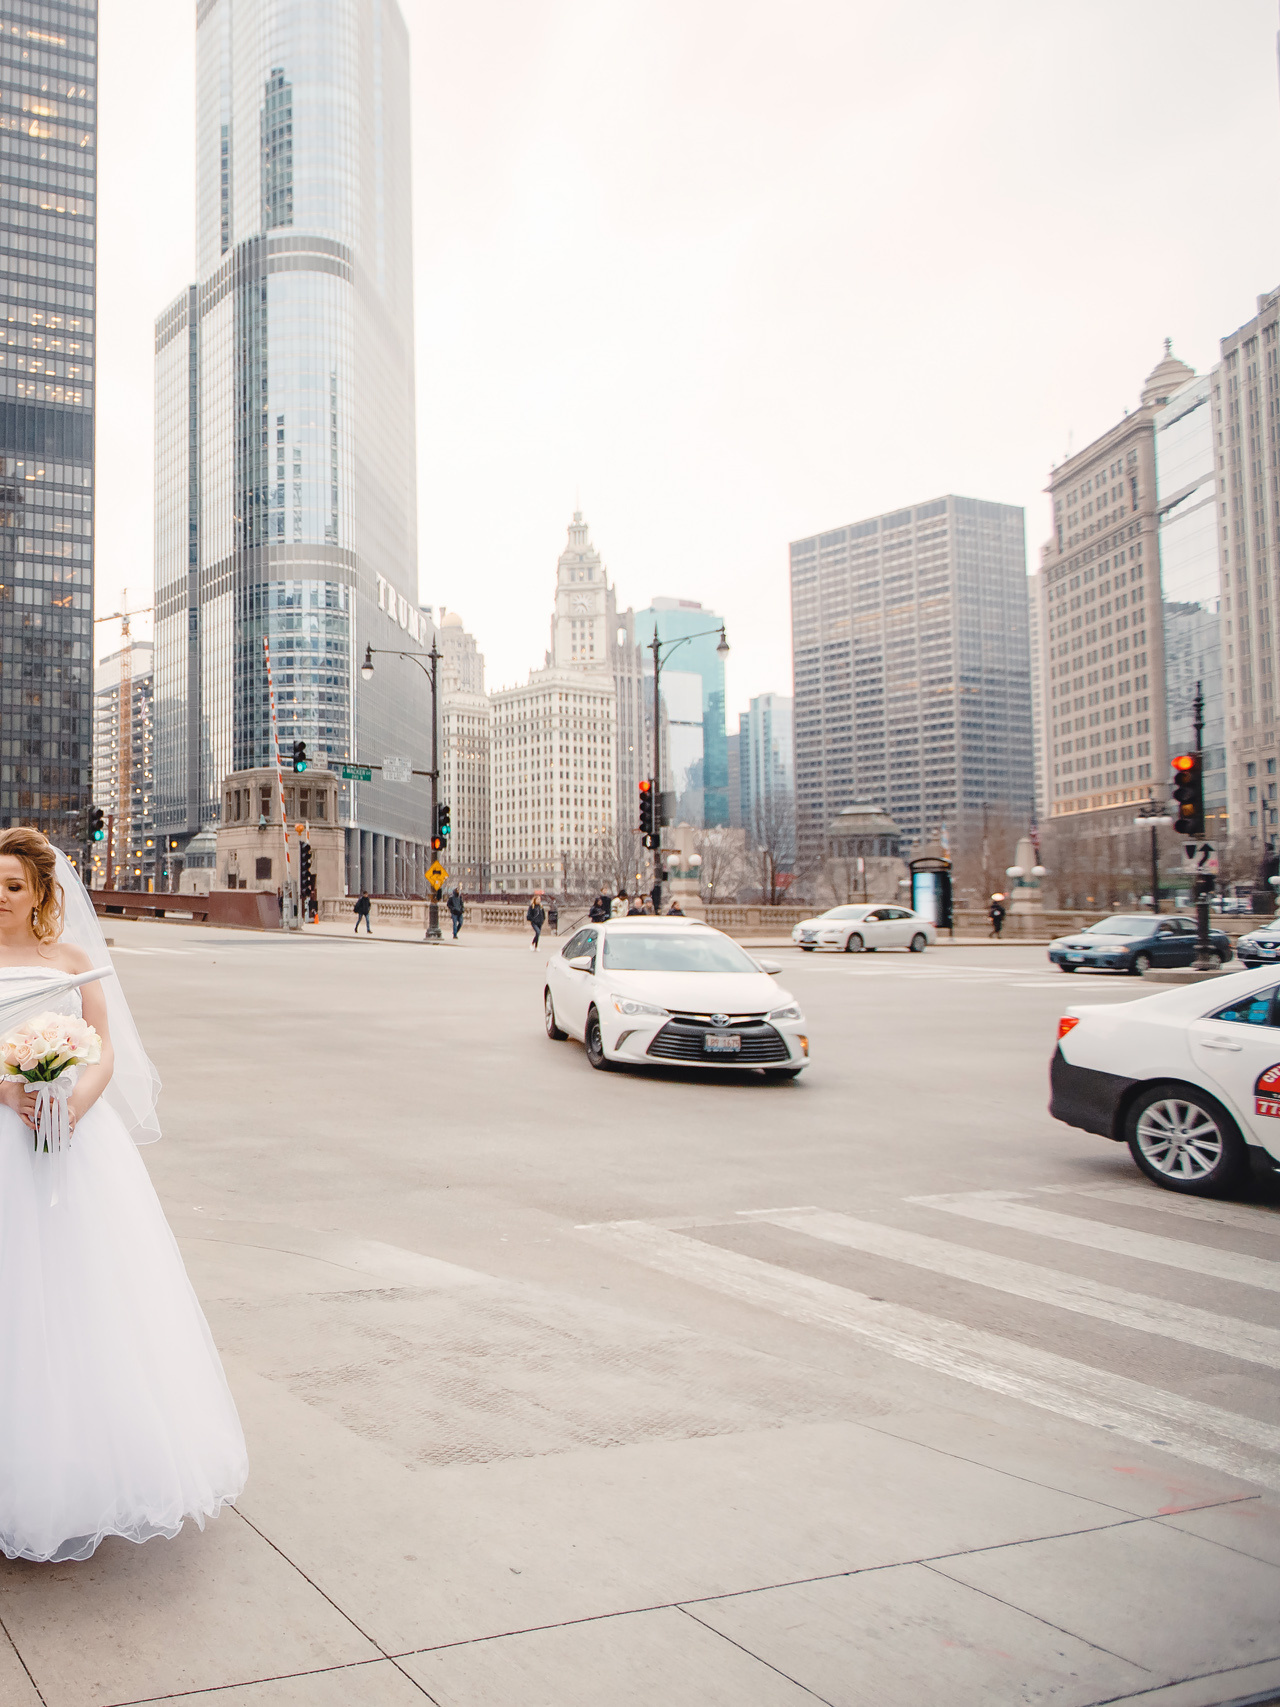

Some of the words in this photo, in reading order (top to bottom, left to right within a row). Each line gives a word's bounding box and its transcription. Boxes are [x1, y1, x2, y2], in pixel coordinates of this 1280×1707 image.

[376, 571, 427, 648] TRUMP
[347, 767, 366, 776] WACKER
[1258, 1100, 1280, 1115] 77
